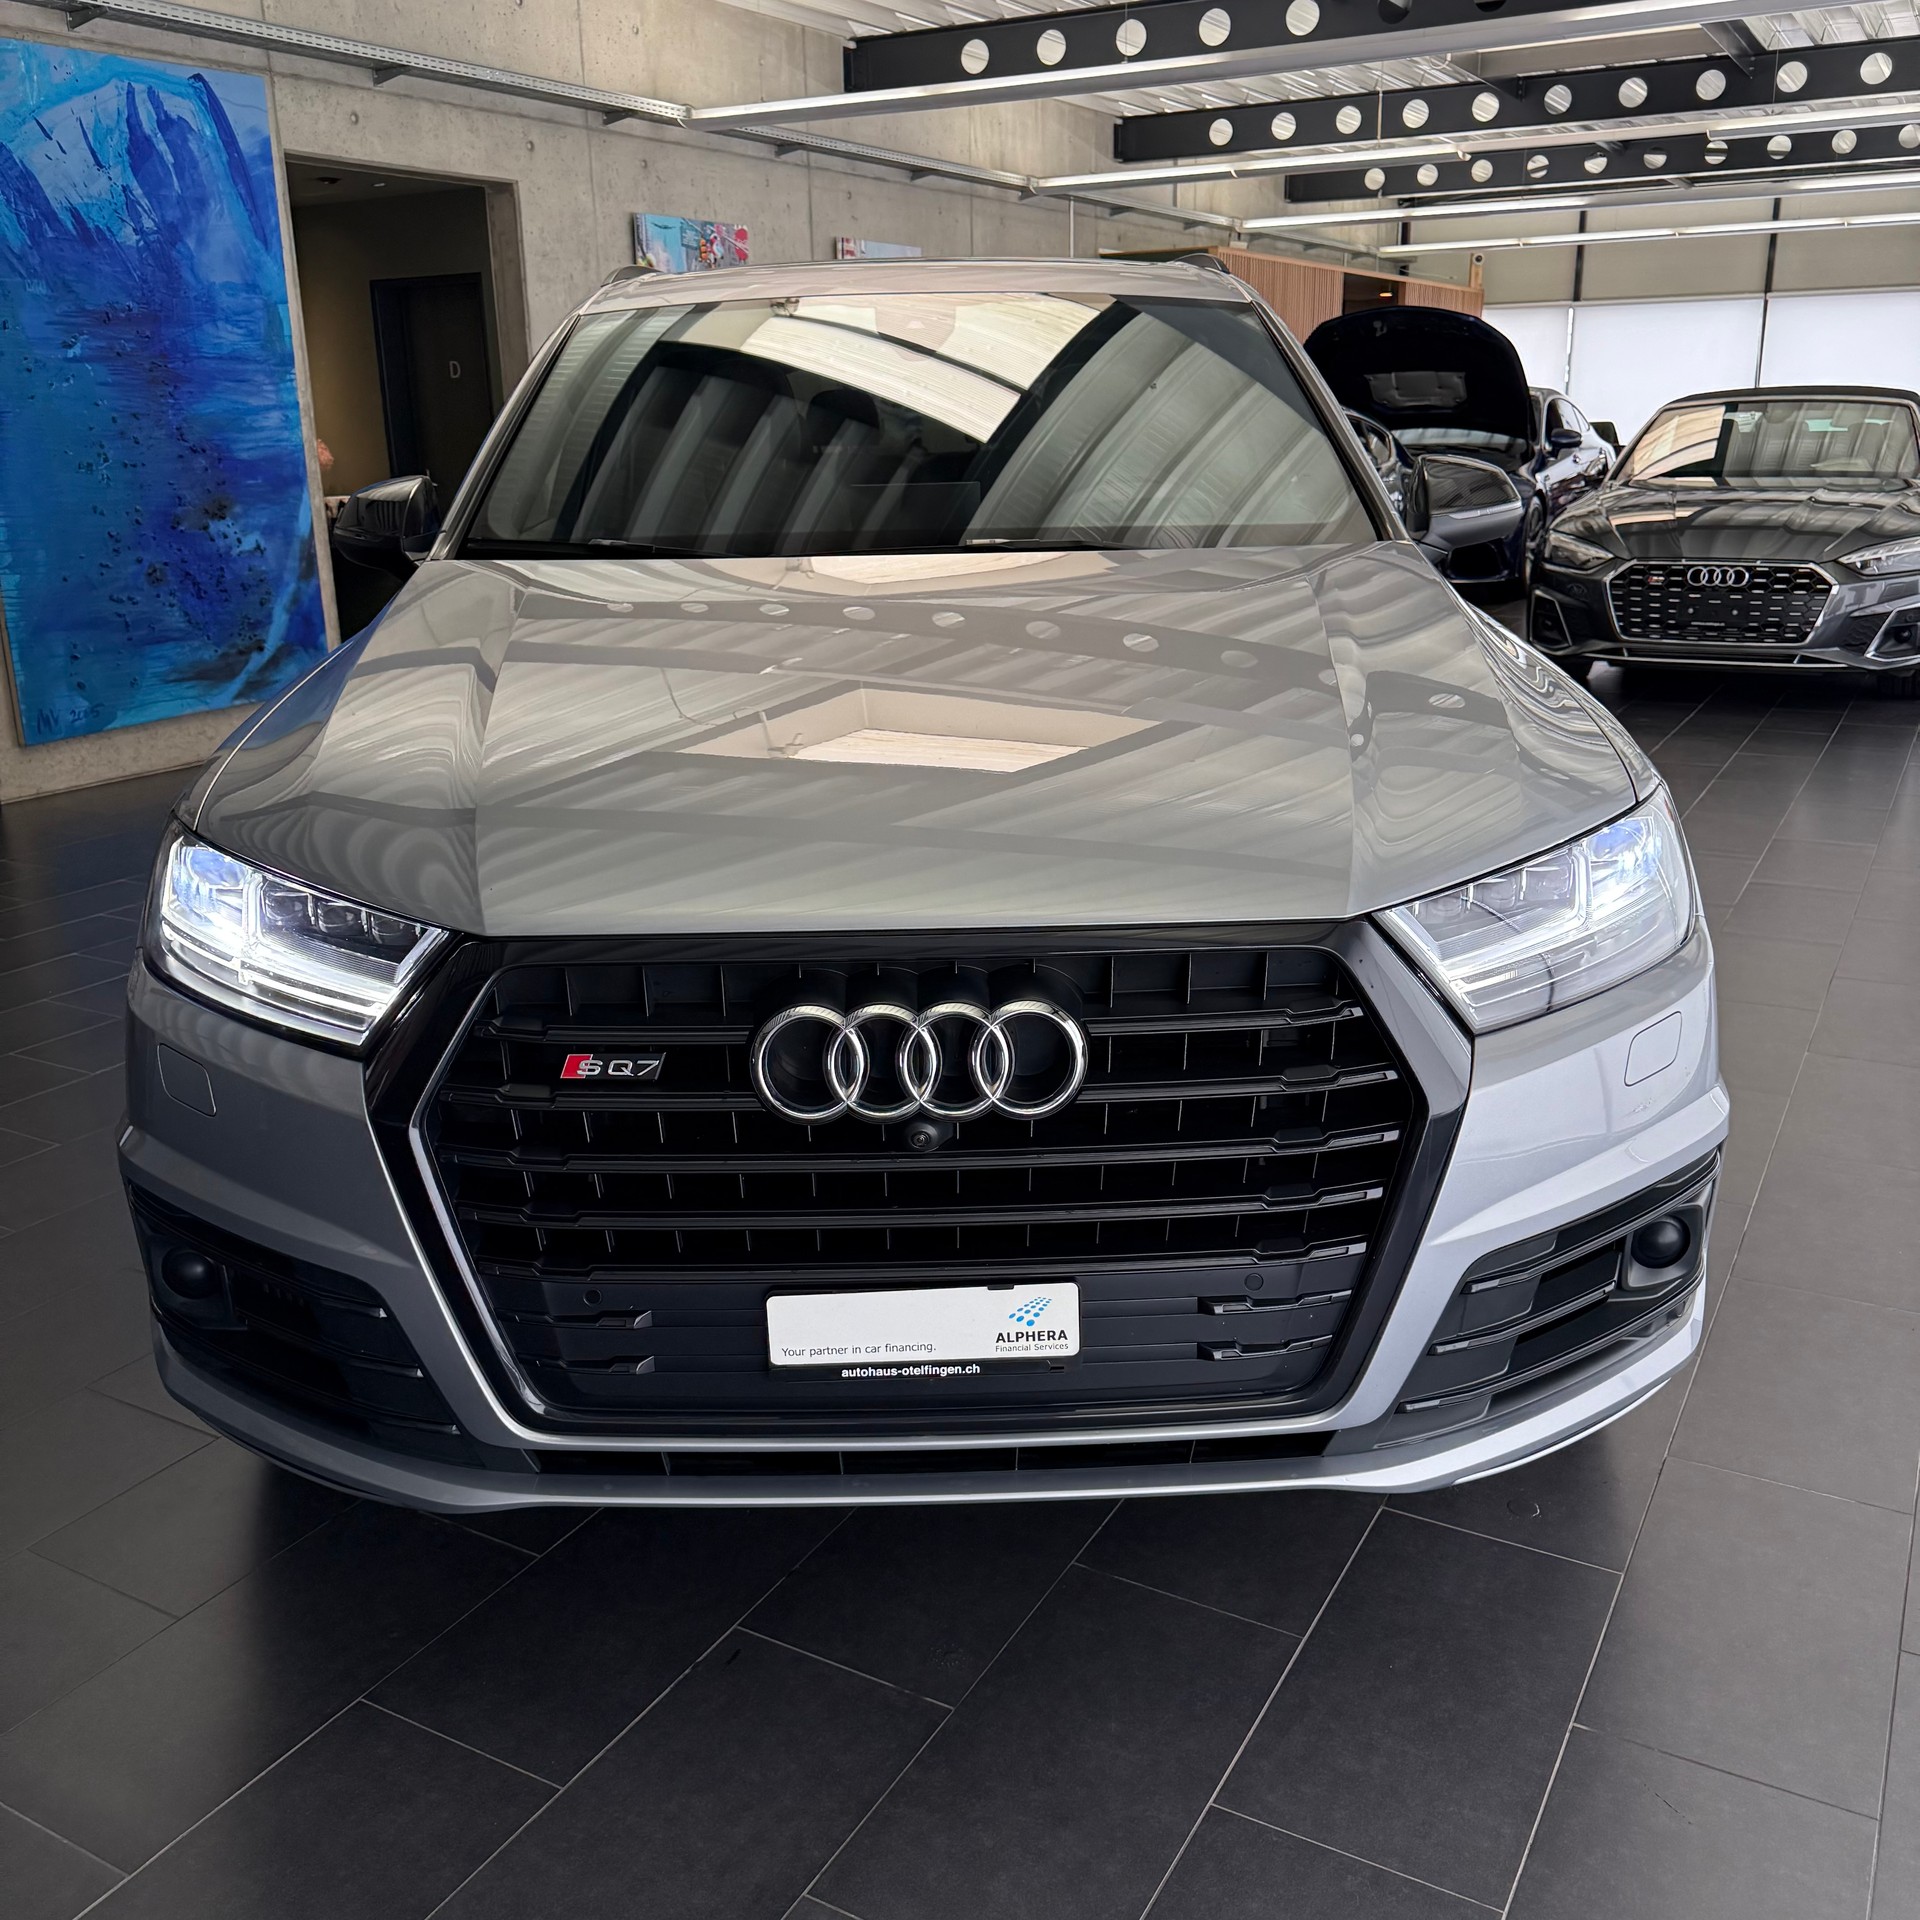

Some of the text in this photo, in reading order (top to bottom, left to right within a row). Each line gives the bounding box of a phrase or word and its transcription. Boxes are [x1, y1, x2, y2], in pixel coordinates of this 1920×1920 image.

[449, 361, 461, 378] D
[995, 1329, 1069, 1344] ALPHERA
[782, 1342, 937, 1358] Your partner in car financing.
[995, 1343, 1069, 1353] Financial Services
[841, 1363, 980, 1378] autohaus-otelfingen.ch
